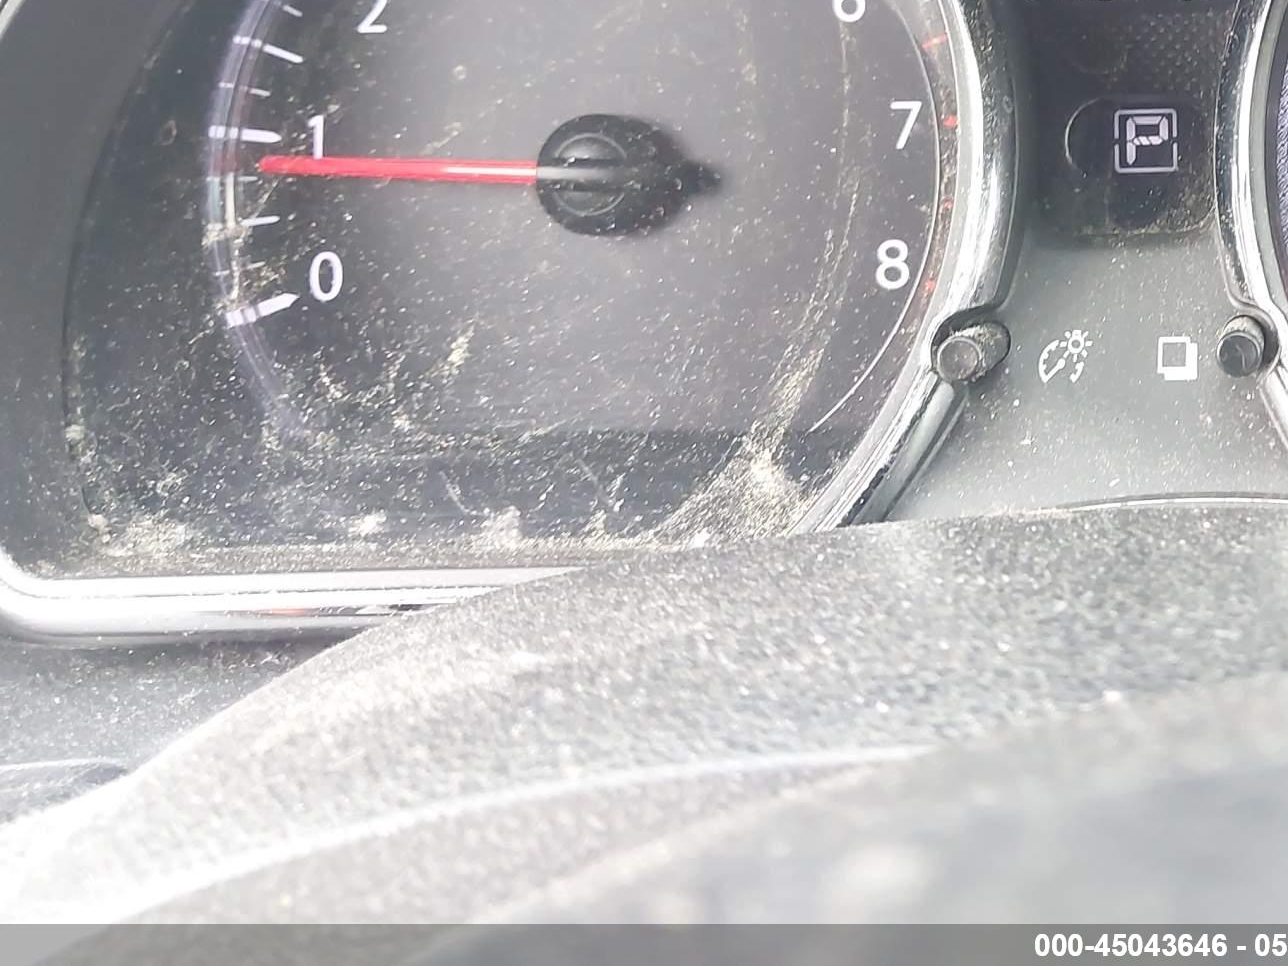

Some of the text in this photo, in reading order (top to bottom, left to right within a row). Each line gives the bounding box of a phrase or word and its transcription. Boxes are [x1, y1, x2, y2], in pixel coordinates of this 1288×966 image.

[308, 116, 324, 159] 1
[890, 102, 922, 148] 7
[1126, 115, 1168, 165] P
[311, 253, 343, 301] 0
[876, 240, 909, 289] 8
